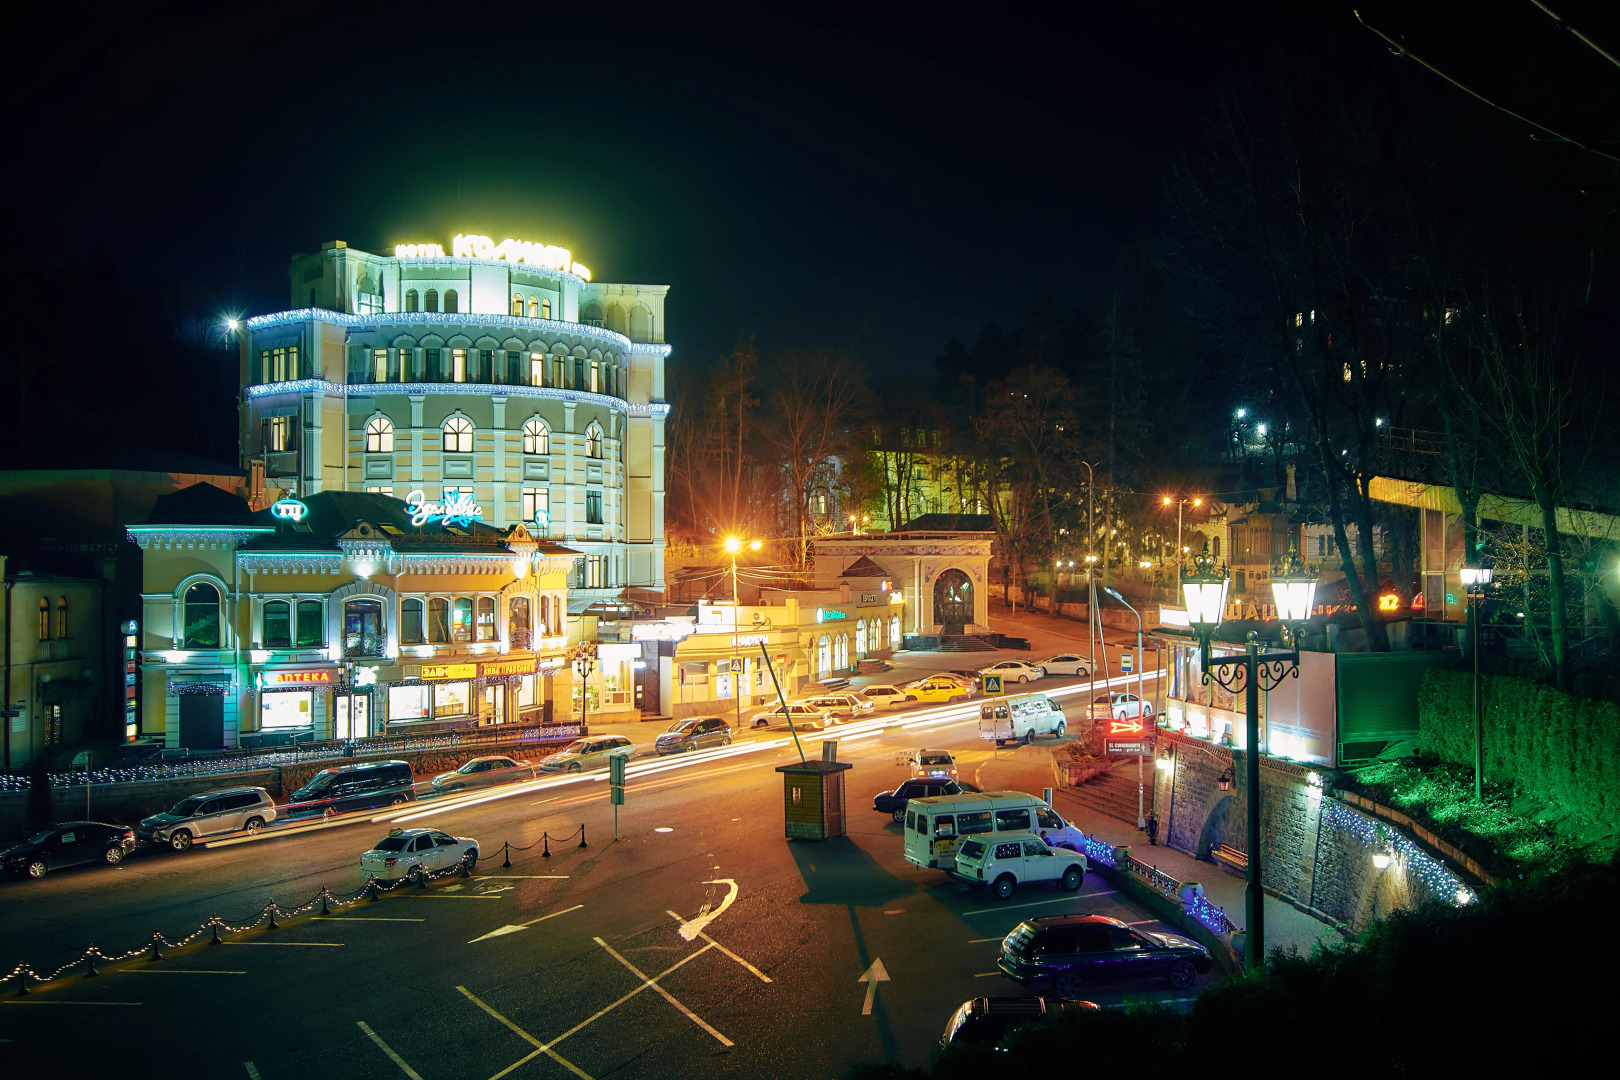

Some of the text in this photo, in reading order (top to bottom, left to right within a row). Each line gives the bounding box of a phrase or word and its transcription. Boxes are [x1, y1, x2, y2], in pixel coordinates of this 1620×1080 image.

[277, 504, 302, 520] ТЦ
[731, 635, 769, 648] ПРОДУКТЫ
[276, 672, 329, 682] АПТЕКА
